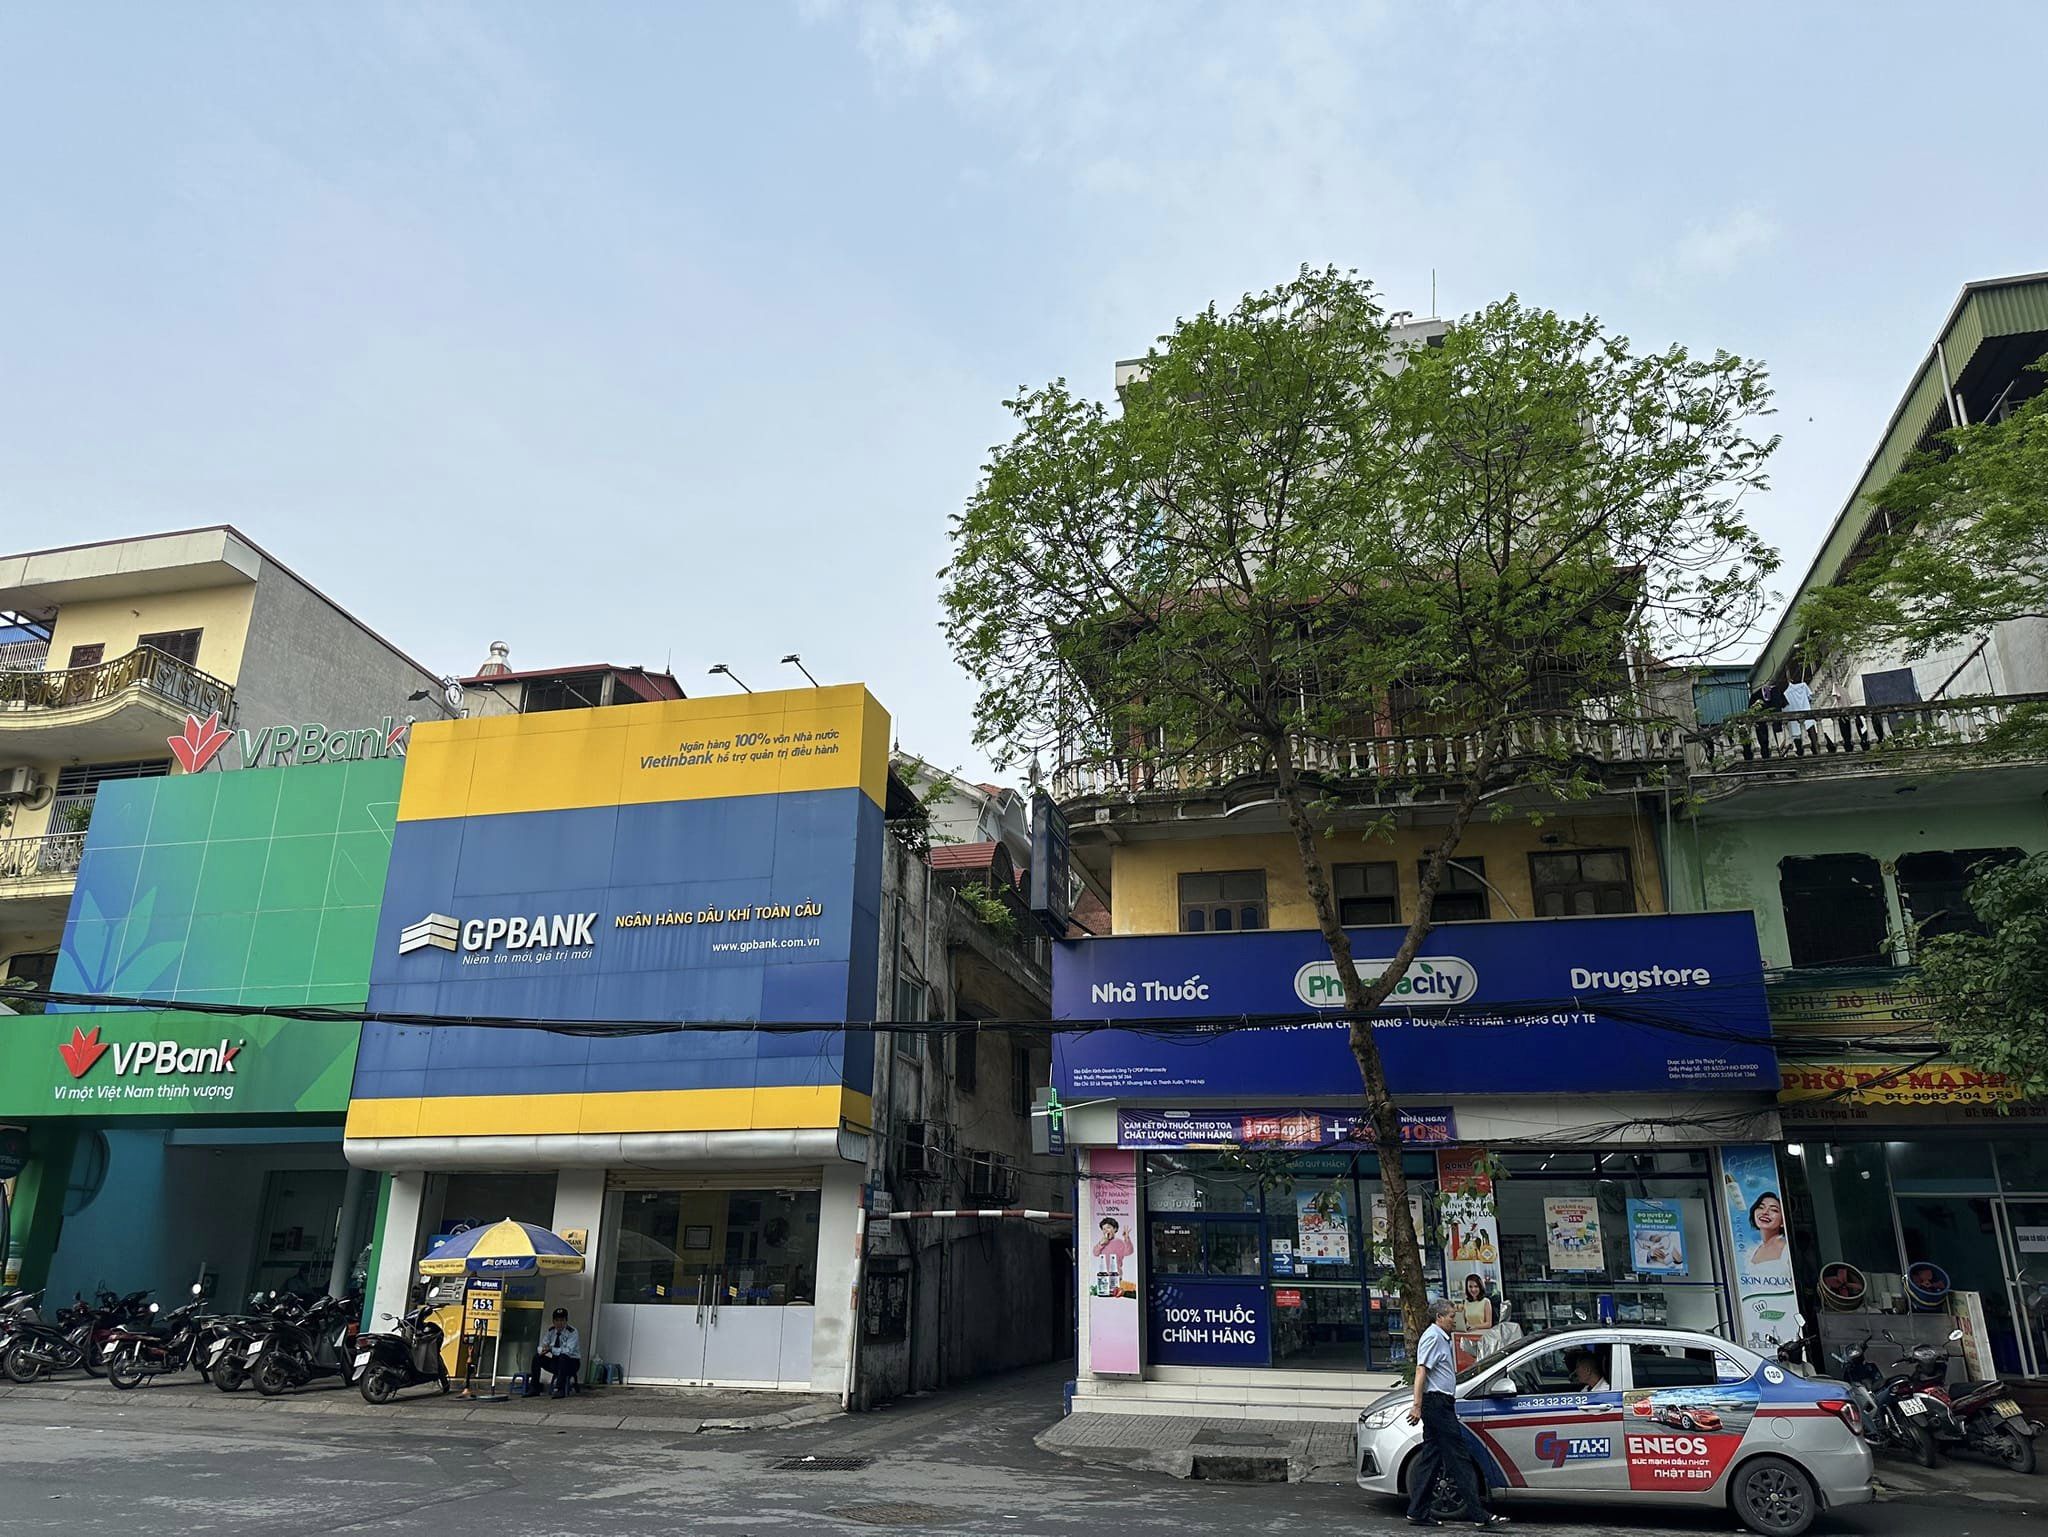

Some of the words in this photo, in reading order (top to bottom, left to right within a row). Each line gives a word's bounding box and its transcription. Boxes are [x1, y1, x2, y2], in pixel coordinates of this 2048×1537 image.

[238, 715, 408, 769] VPBank
[680, 741, 704, 753] Ngân
[707, 739, 731, 750] hàng
[735, 732, 771, 747] 100%
[793, 731, 812, 742] Nhà
[815, 729, 839, 740] nước
[640, 751, 714, 769] Vietinbank
[815, 744, 839, 755] hành
[615, 911, 652, 928] NGÂN
[655, 909, 694, 926] HÀNG
[697, 903, 724, 923] DẦU
[728, 903, 753, 921] KHÍ
[756, 902, 791, 920] TOÀN
[795, 897, 823, 917] CẦU
[462, 912, 598, 951] GPBANK
[712, 937, 820, 953] www.gpbank.com.vn
[462, 952, 490, 965] Niềm
[494, 953, 508, 963] tin
[535, 951, 552, 963] giá
[555, 949, 568, 961] trị
[571, 947, 593, 959] mới
[1570, 965, 1711, 993] Drugstore
[1092, 982, 1137, 1003] Nhà
[1142, 975, 1210, 1002] Thuốc
[1552, 1013, 1568, 1027] CỤ
[1570, 1013, 1579, 1024] Y
[112, 1038, 240, 1076] VPBank
[68, 1086, 94, 1102] một
[97, 1085, 121, 1102] Việt
[124, 1085, 155, 1099] Nam
[157, 1084, 190, 1101] thịnh
[193, 1084, 235, 1100] vượng
[1955, 1092, 1981, 1100] 304
[1195, 1121, 1214, 1129] THEO
[1216, 1121, 1232, 1129] TOA
[1147, 1129, 1177, 1141] LƯỢNG
[1178, 1129, 1206, 1139] CHÍNH
[1741, 1276, 1762, 1285] SKIN
[1165, 1308, 1201, 1322] 100%
[1204, 1303, 1256, 1323] THUỐC
[1162, 1325, 1208, 1342] CHÍNH
[1212, 1326, 1256, 1344] HÃNG
[1533, 1398, 1545, 1407] 32
[1547, 1397, 1559, 1406] 32
[1561, 1396, 1573, 1405] 32
[1575, 1396, 1588, 1405] 32
[1569, 1438, 1609, 1454] TAXI
[1628, 1437, 1708, 1455] ENEOS
